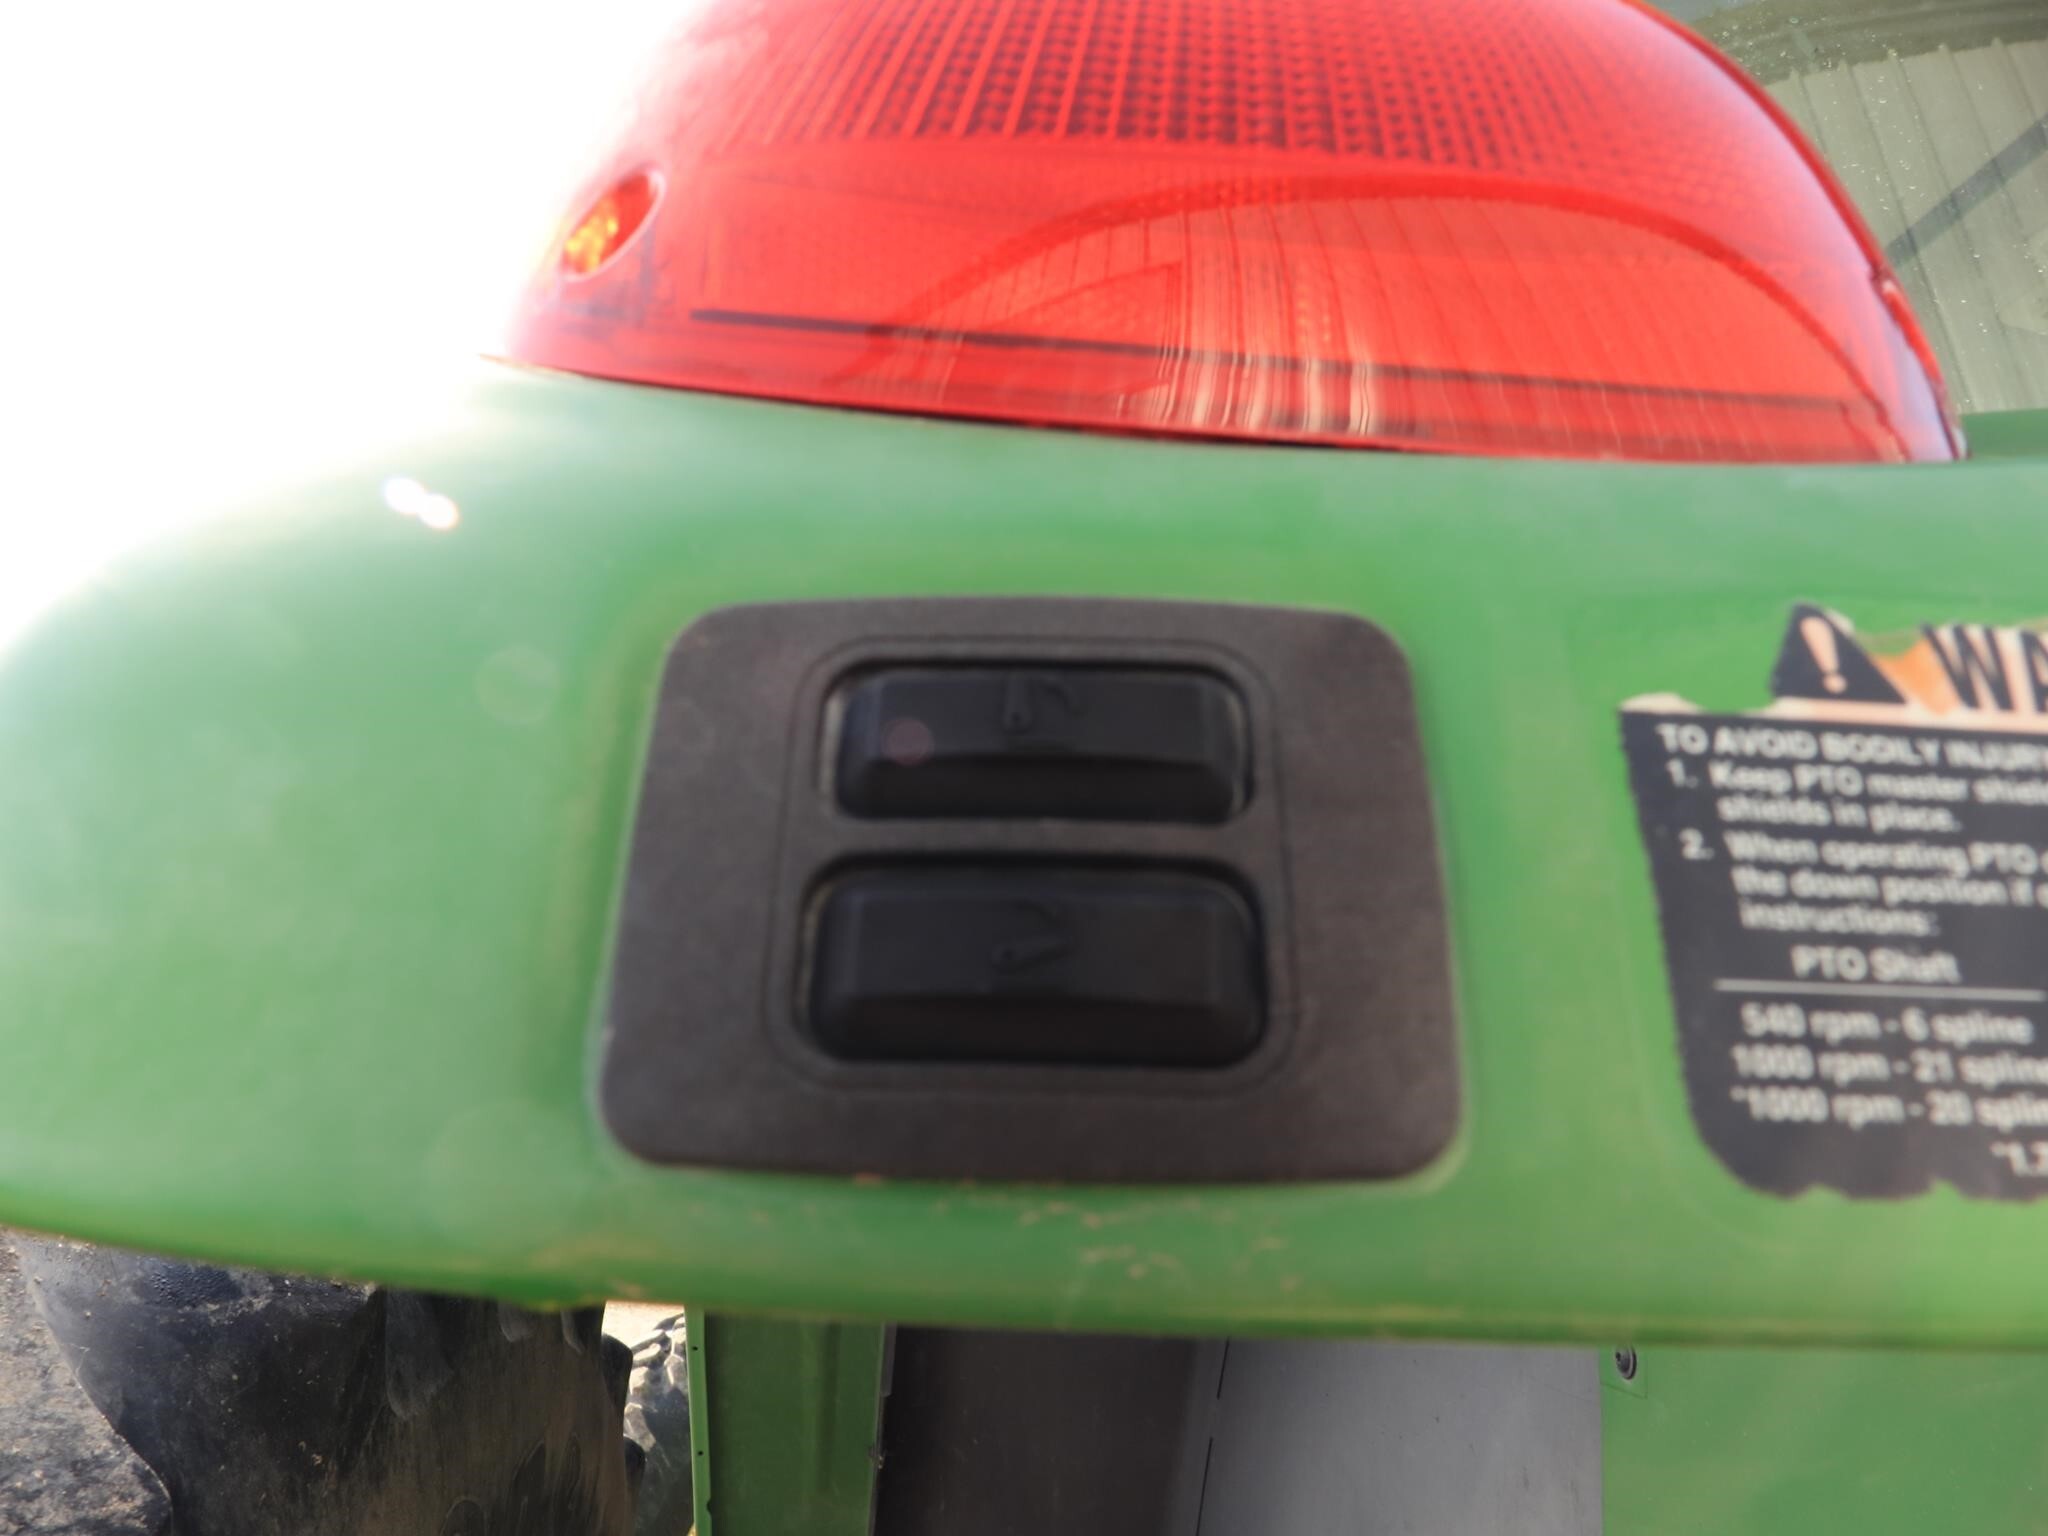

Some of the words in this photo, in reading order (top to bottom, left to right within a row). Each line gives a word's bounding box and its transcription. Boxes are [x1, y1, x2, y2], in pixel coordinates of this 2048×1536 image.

[1655, 723, 1708, 754] TO
[1713, 726, 1818, 760] AVOID
[1819, 732, 1940, 766] BODILY
[1666, 758, 1698, 788] 1.
[1708, 760, 1792, 794] Keep
[1793, 763, 1863, 797] PTO
[1866, 773, 1968, 801] master
[1717, 793, 1831, 826] shields
[1832, 797, 1867, 828] in
[1868, 799, 1963, 834] place.
[1679, 828, 1714, 861] 2.
[1723, 830, 1818, 864] When
[1821, 838, 1970, 878] operating
[1967, 841, 2037, 875] PTO
[1790, 867, 1878, 899] down
[1880, 872, 2008, 906] position
[1790, 944, 1867, 980] PTO
[1869, 945, 1961, 983] Shaft
[1741, 1002, 1806, 1037] 540
[1809, 1011, 1881, 1045] rpm
[1901, 1006, 1929, 1042] 6
[1930, 1009, 2034, 1048] spline
[1731, 1043, 1815, 1080] 1000
[1818, 1052, 1890, 1087] rpm
[1910, 1049, 1954, 1083] 21
[1832, 1094, 1904, 1130] rpm
